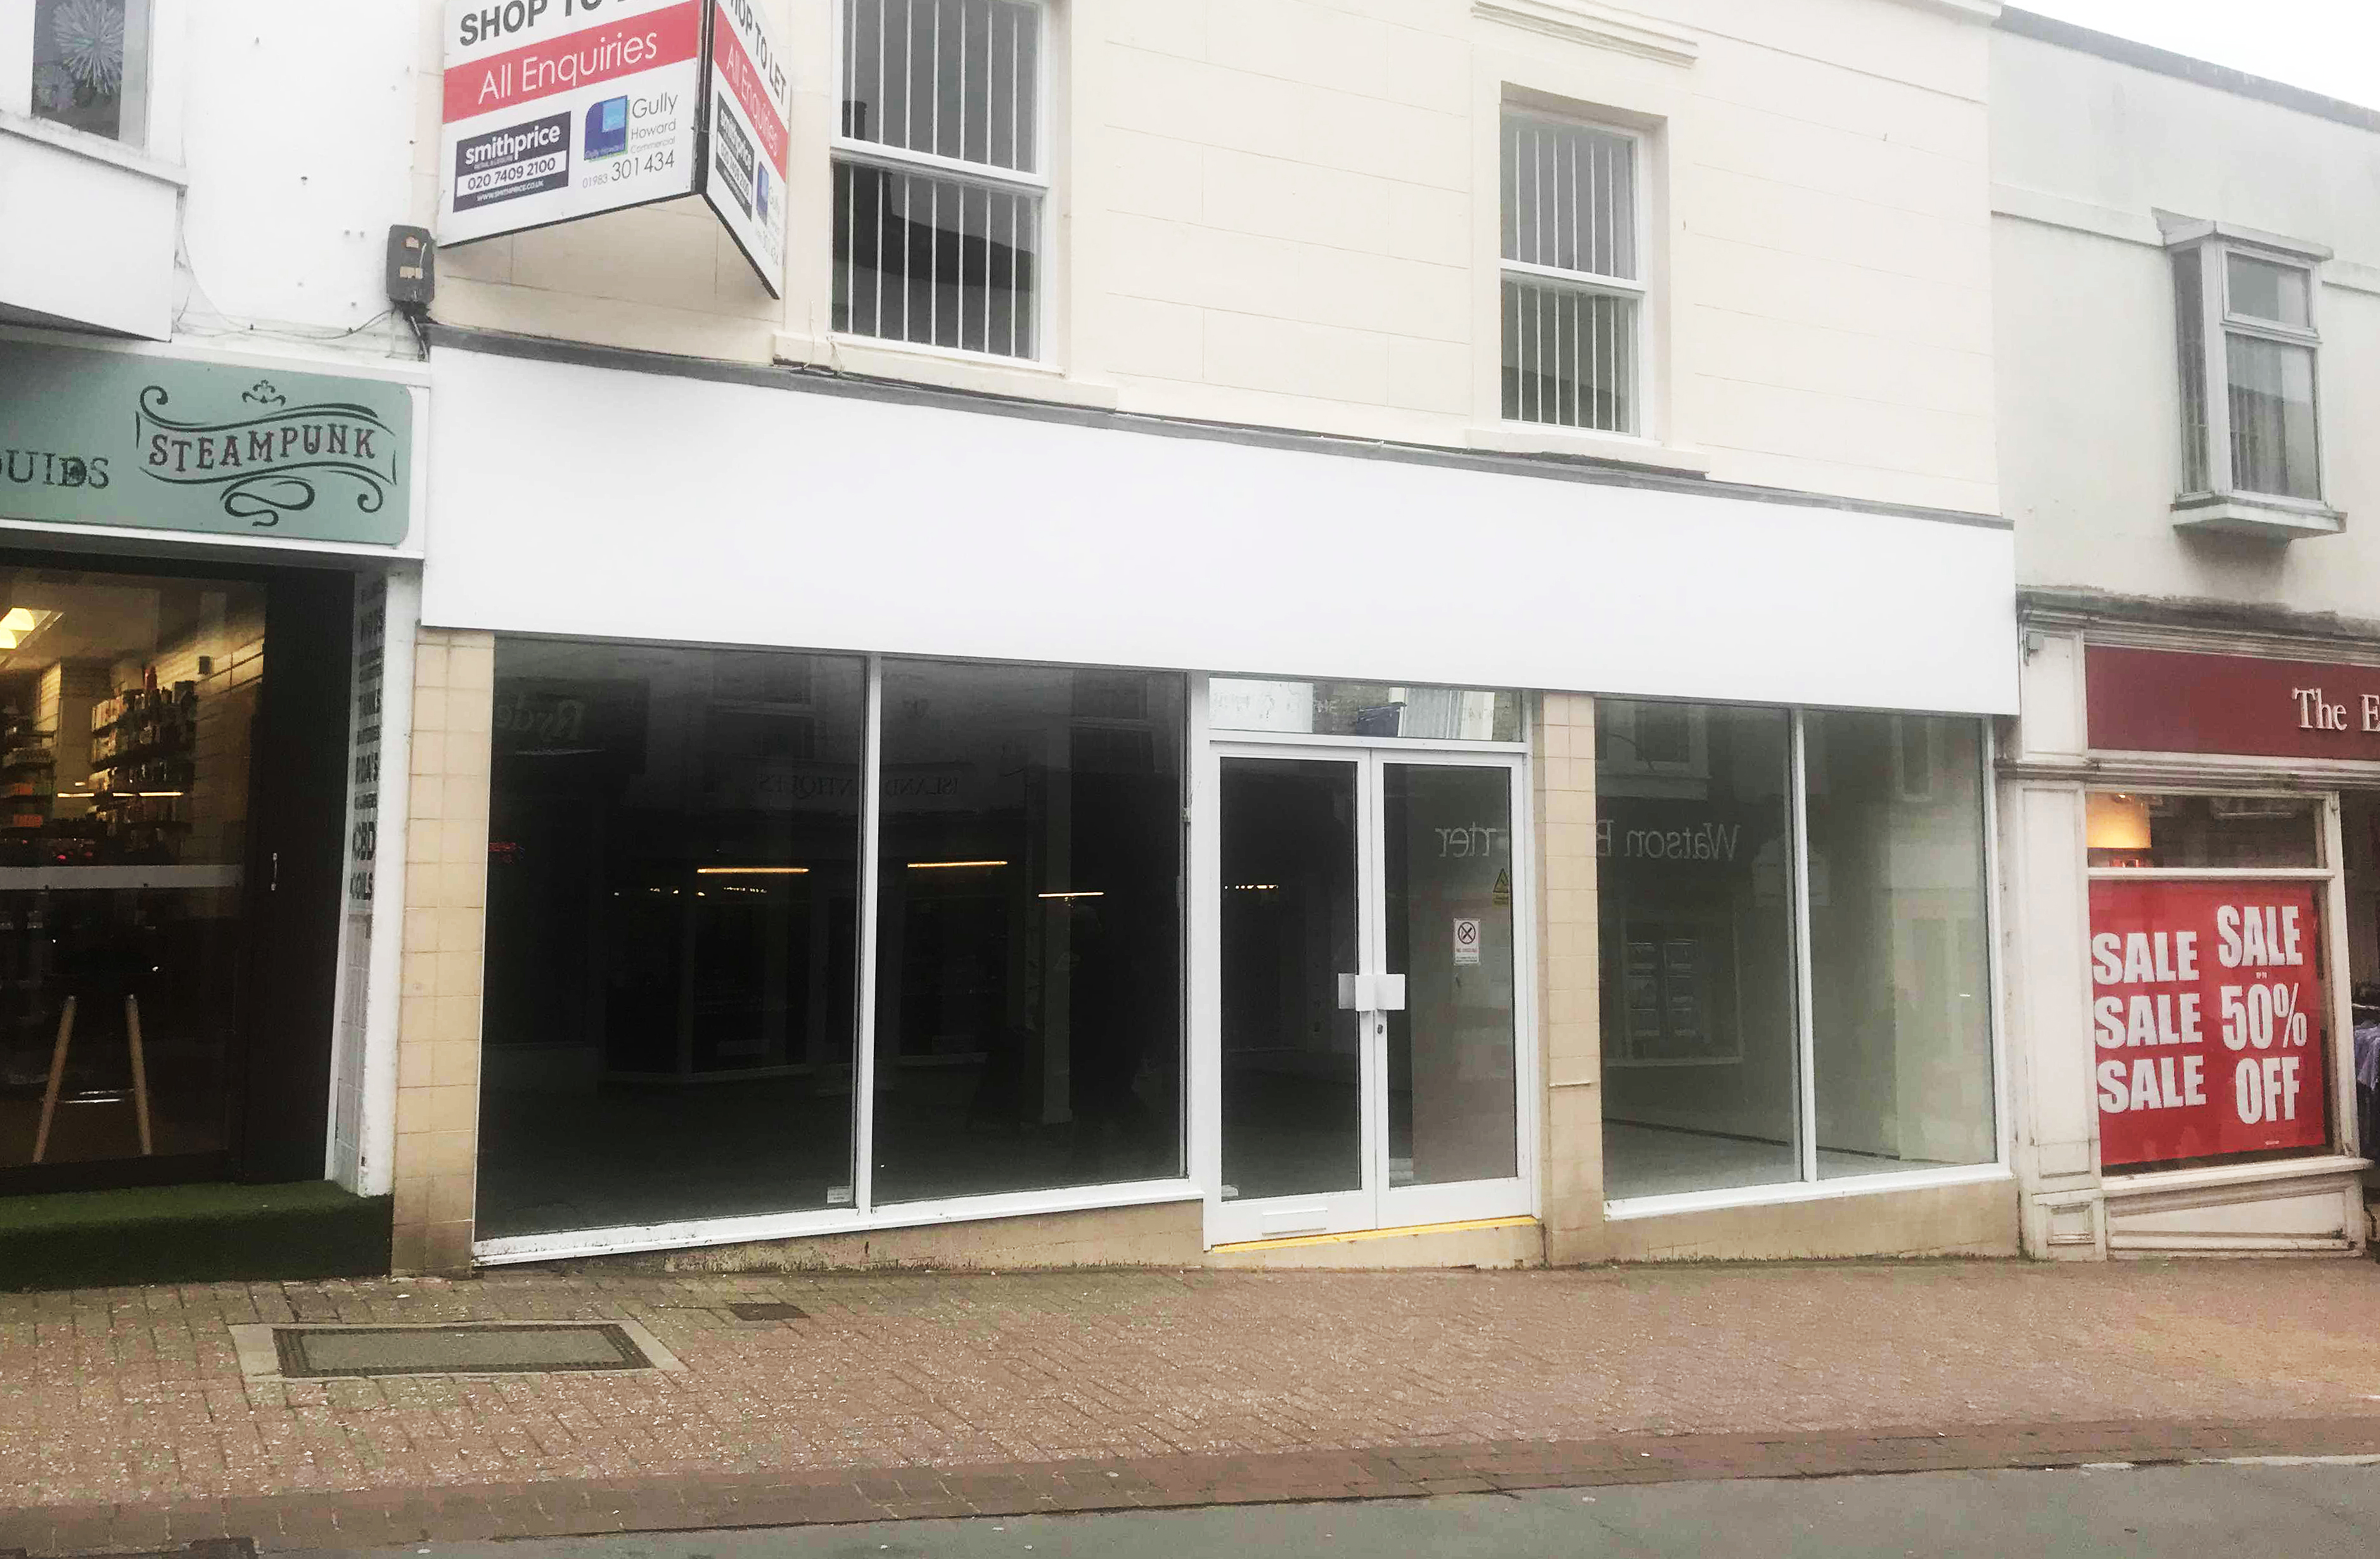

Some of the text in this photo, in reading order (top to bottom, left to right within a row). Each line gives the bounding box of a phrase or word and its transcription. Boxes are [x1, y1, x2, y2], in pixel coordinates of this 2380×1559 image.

[459, 0, 547, 46] SHOP
[478, 32, 658, 105] All Enquiries
[755, 22, 767, 70] TO
[769, 52, 786, 105] LET
[632, 92, 678, 119] Gully
[726, 44, 740, 87] All
[741, 64, 777, 157] Enquiries
[464, 125, 561, 165] smithprice
[631, 119, 676, 140] Howard
[468, 173, 490, 190] 020
[494, 166, 523, 184] 7409
[527, 157, 556, 176] 2100
[582, 174, 608, 189] 01983
[611, 157, 639, 181] 301
[644, 149, 675, 172] 434
[0, 449, 109, 489] UIDS
[148, 423, 376, 473] STEAMPUNK
[2291, 688, 2347, 731] The
[2092, 931, 2200, 985] SALE
[2217, 904, 2304, 970] SALE
[2095, 993, 2203, 1049] SALE
[2220, 982, 2308, 1052] 50%
[2097, 1056, 2207, 1115] SALE
[2236, 1056, 2300, 1125] OFF
